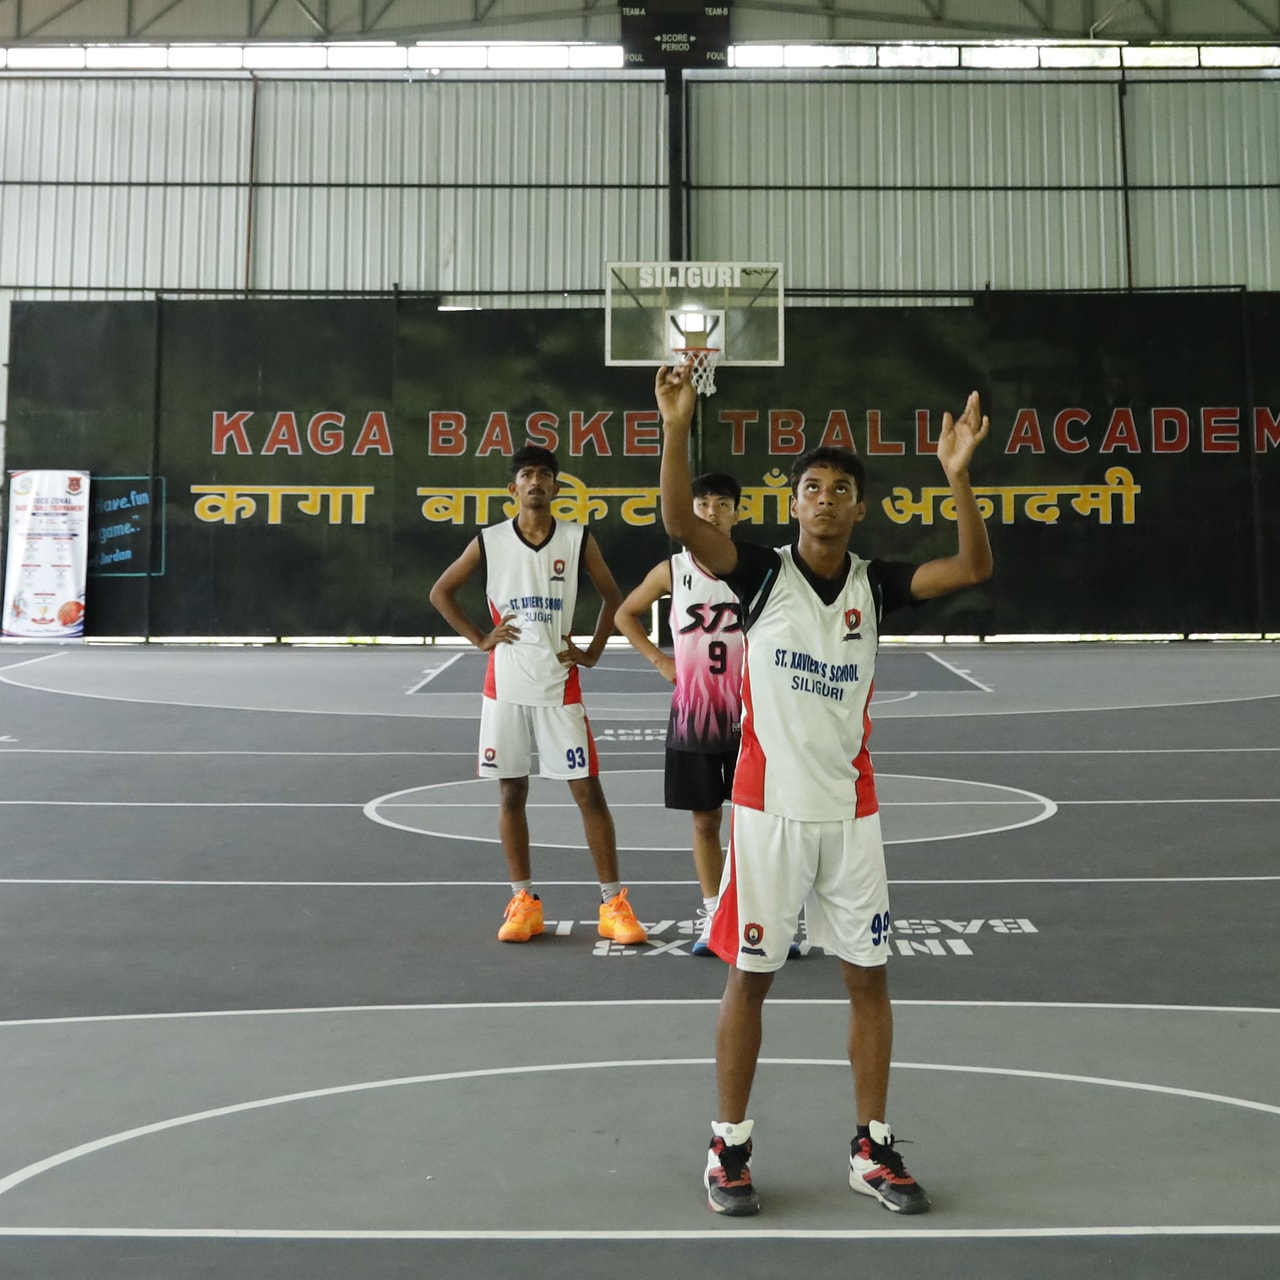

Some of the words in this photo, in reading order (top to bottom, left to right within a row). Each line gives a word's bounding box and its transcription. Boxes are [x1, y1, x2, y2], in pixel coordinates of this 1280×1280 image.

[622, 7, 646, 16] TEAM-A
[705, 7, 729, 16] TEAM-B
[662, 34, 688, 42] SCORE
[662, 43, 690, 51] PERIOD
[624, 53, 644, 62] FOUL
[706, 52, 726, 60] FOUL
[639, 266, 741, 288] SILIGURI
[212, 411, 394, 456] KAGA
[190, 484, 375, 525] कागा
[709, 641, 727, 675] 9
[775, 648, 788, 668] ST.
[790, 652, 827, 678] XAVIER'S
[830, 663, 859, 683] SCHOOL
[791, 676, 844, 701] SILIGURI
[566, 747, 586, 769] 93
